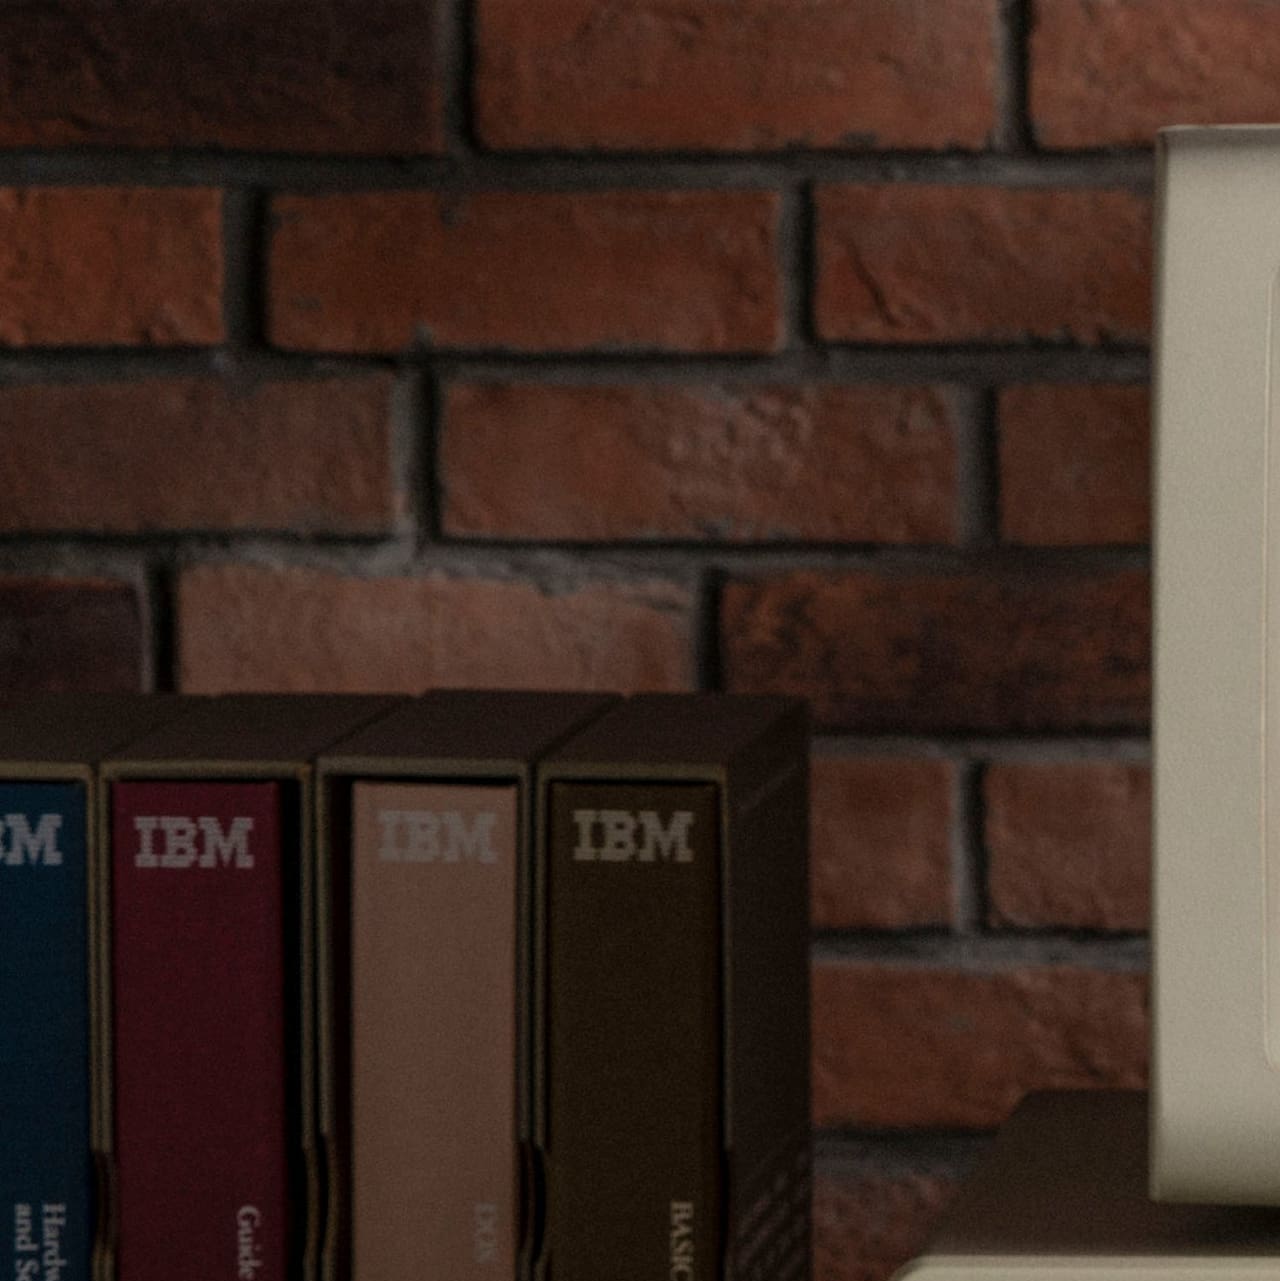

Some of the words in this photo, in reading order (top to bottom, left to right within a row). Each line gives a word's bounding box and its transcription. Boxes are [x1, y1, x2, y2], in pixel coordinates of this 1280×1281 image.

[0, 814, 63, 867] M
[134, 816, 255, 868] IBM
[377, 810, 499, 863] IBM
[572, 810, 695, 863] IBM
[14, 1203, 38, 1251] and
[236, 1204, 262, 1280] Guide
